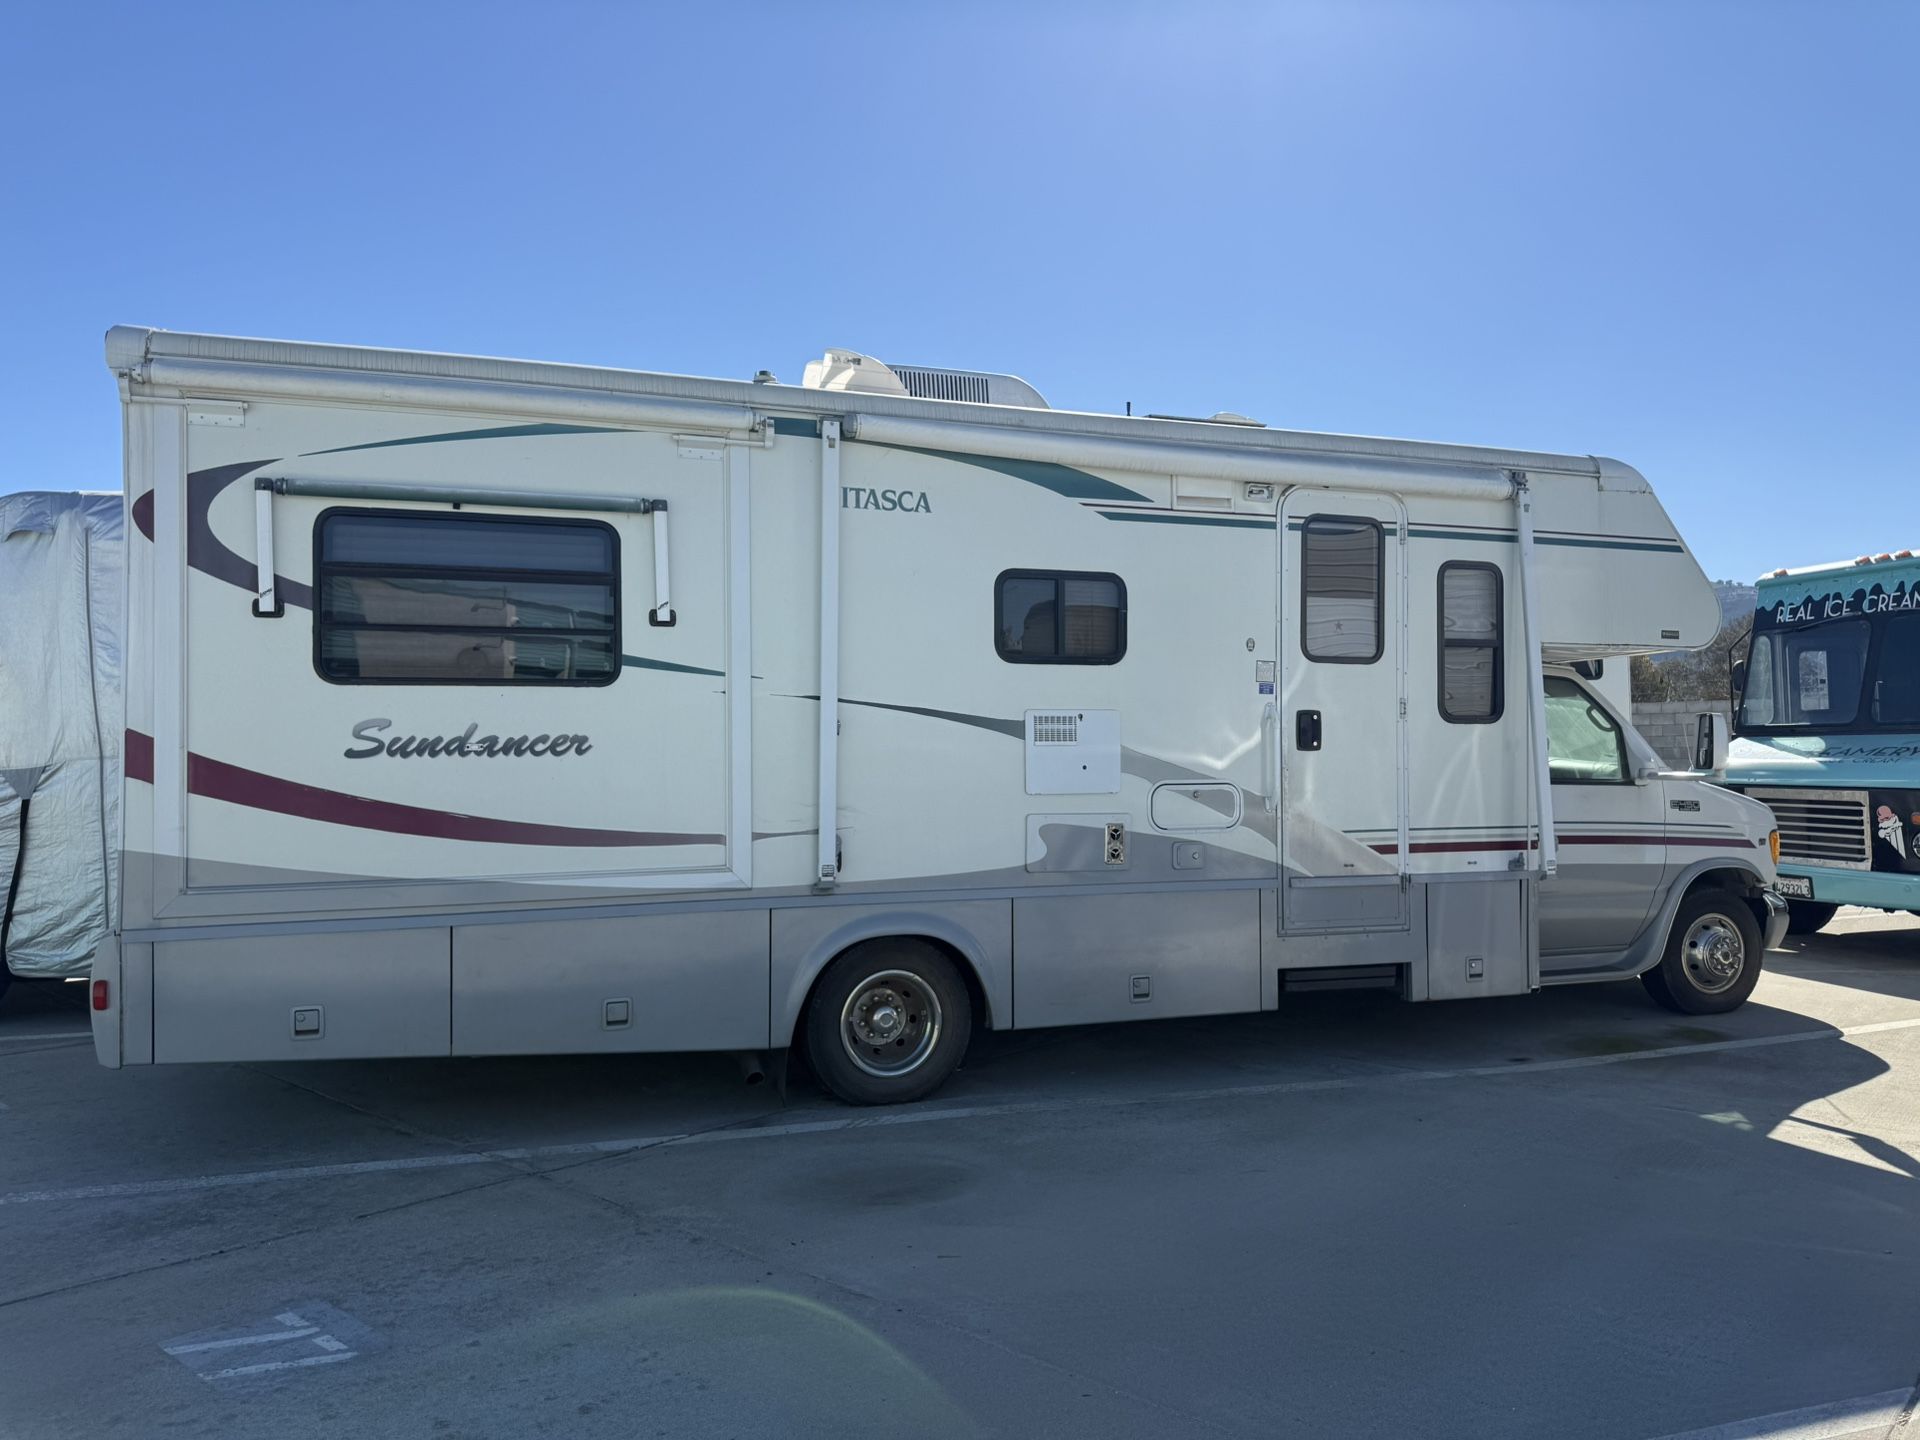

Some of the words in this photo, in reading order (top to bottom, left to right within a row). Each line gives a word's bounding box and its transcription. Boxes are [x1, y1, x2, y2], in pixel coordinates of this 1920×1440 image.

[841, 486, 932, 513] ITASCA
[1776, 602, 1815, 623] REAL
[1824, 597, 1854, 618] ICE
[344, 717, 593, 760] Sundancer
